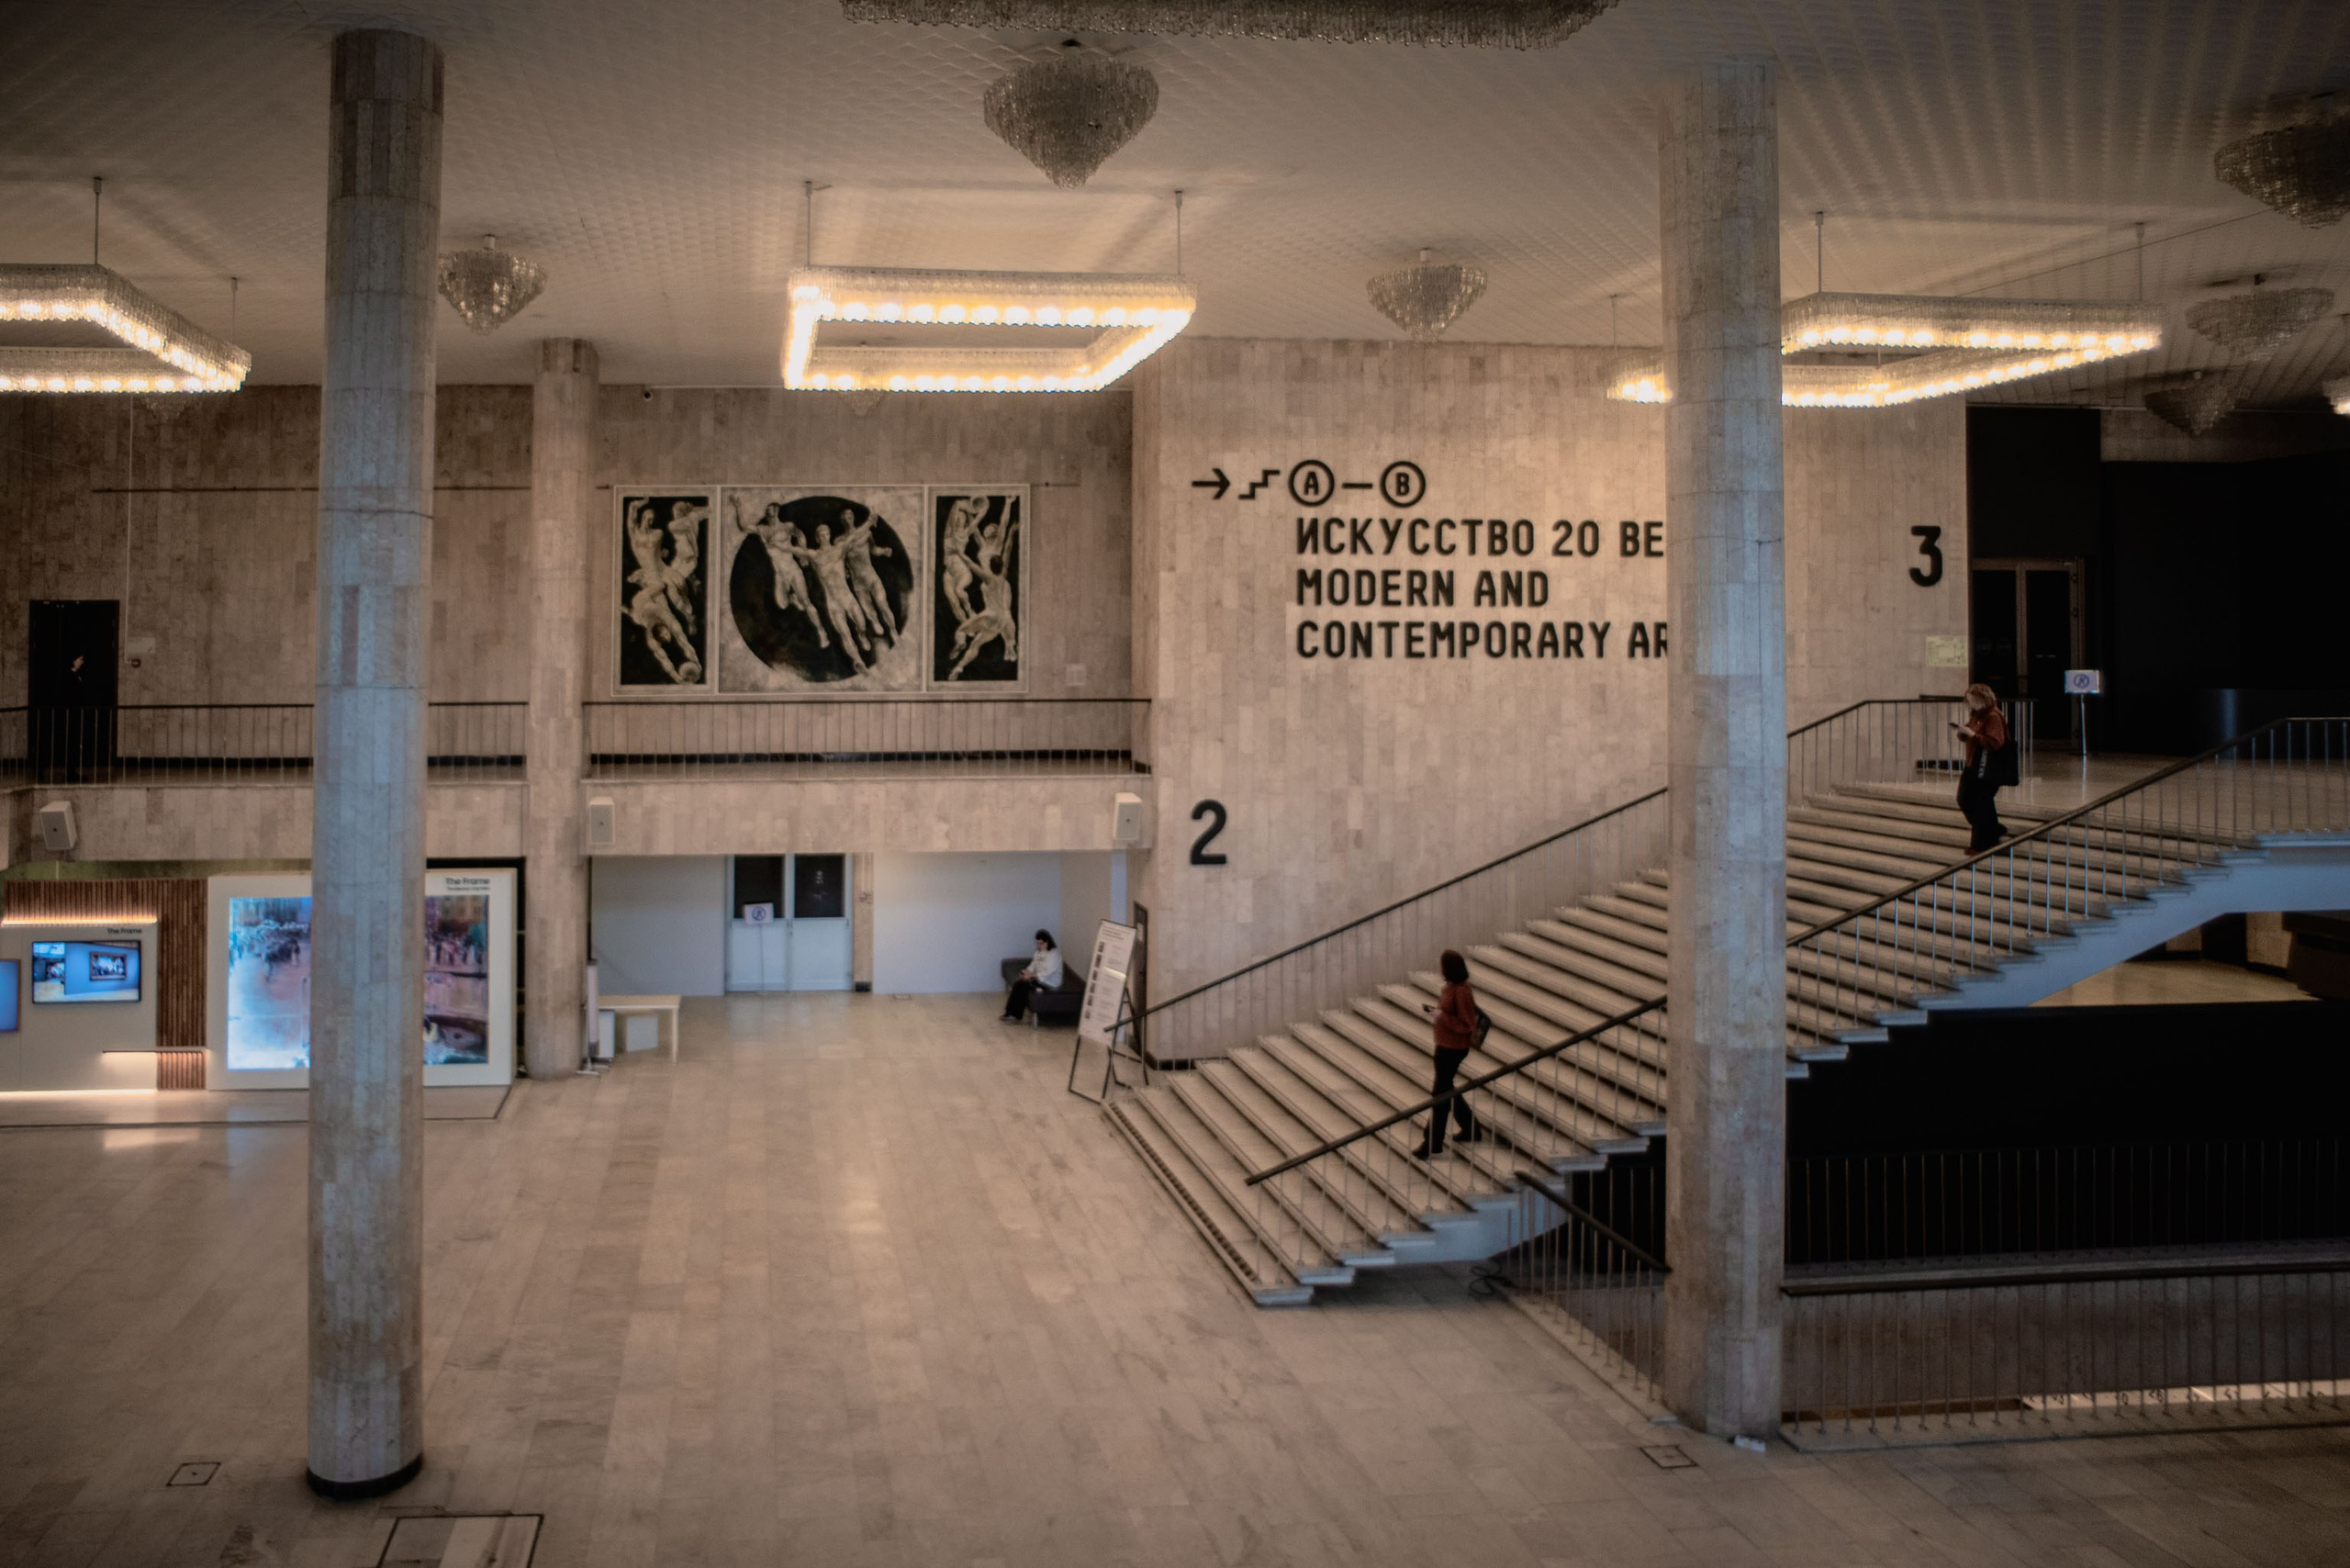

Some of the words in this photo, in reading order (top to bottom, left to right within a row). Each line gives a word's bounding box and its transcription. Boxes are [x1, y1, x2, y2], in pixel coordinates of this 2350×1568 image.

[1304, 470, 1319, 496] A
[1296, 517, 1534, 556] ИСКУССТВО
[1552, 520, 1599, 557] 20
[1619, 521, 1664, 557] ВЕ
[1908, 524, 1943, 588] 3
[1296, 568, 1454, 607] MODERN
[1474, 570, 1549, 608] AND
[1296, 620, 1611, 659] CONTEMPORARY
[1190, 800, 1227, 866] 2
